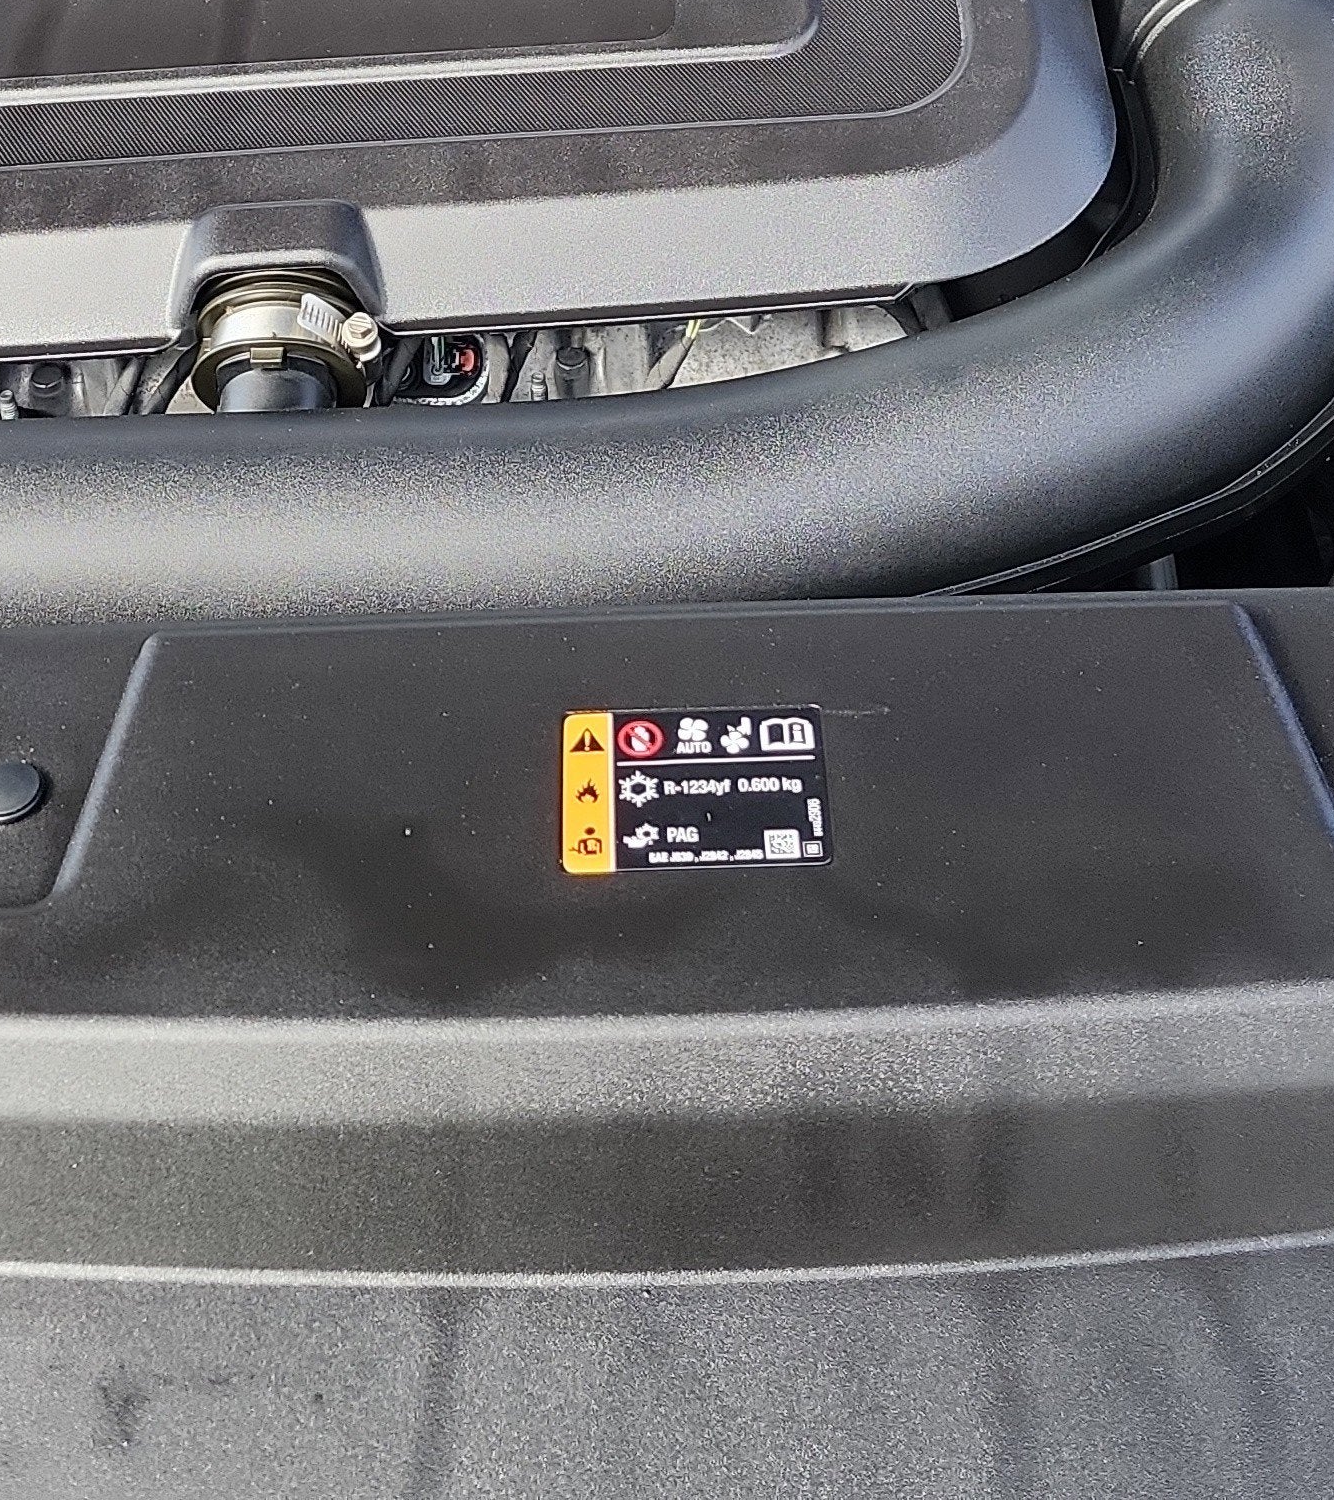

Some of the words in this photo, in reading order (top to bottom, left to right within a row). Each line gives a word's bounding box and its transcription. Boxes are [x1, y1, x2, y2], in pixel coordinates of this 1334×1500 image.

[676, 741, 712, 754] AUTO
[663, 778, 731, 797] R-1234yf
[737, 777, 780, 793] 0.600
[782, 776, 803, 793] kg
[667, 826, 700, 843] PAG
